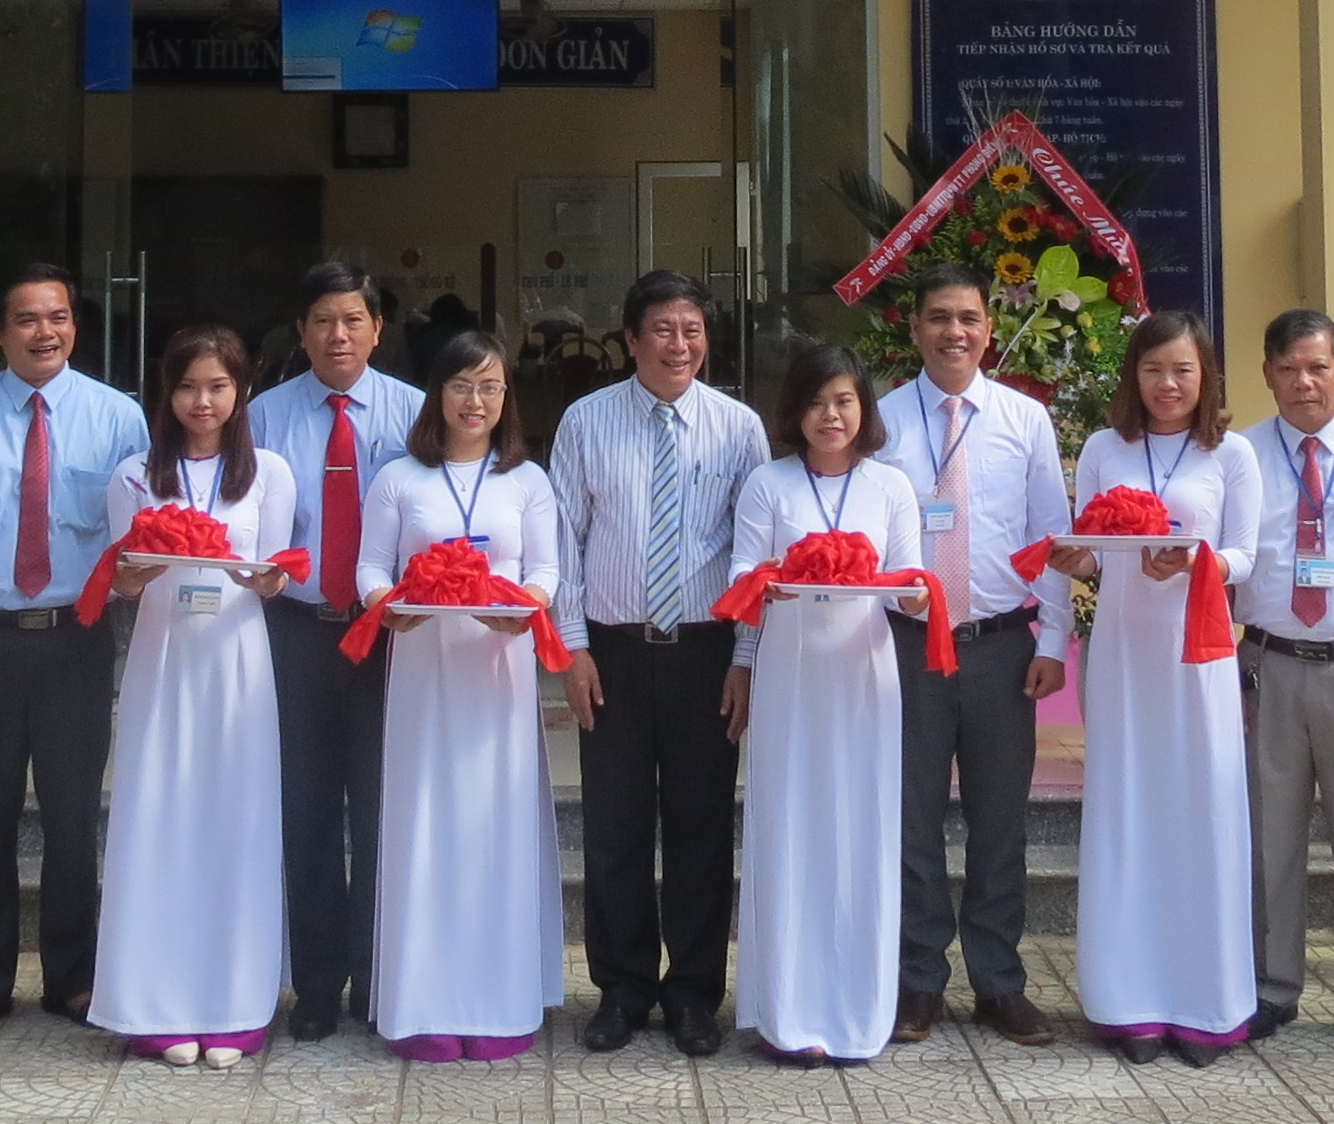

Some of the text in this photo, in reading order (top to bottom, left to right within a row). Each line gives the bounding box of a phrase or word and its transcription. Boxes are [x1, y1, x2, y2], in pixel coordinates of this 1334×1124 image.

[991, 19, 1137, 38] BẢNG HƯỚNG DẪN
[557, 26, 630, 71] GIẢN
[957, 41, 986, 54] TIẾP
[990, 42, 1025, 57] NHẬN
[1050, 43, 1067, 54] SƠ
[1069, 41, 1086, 54] VÀ
[1089, 41, 1114, 54] TRẢ
[1116, 40, 1142, 54] KẾT
[1144, 40, 1171, 55] QUẢ
[961, 155, 986, 179] PHONG
[1033, 147, 1084, 206] Chúc
